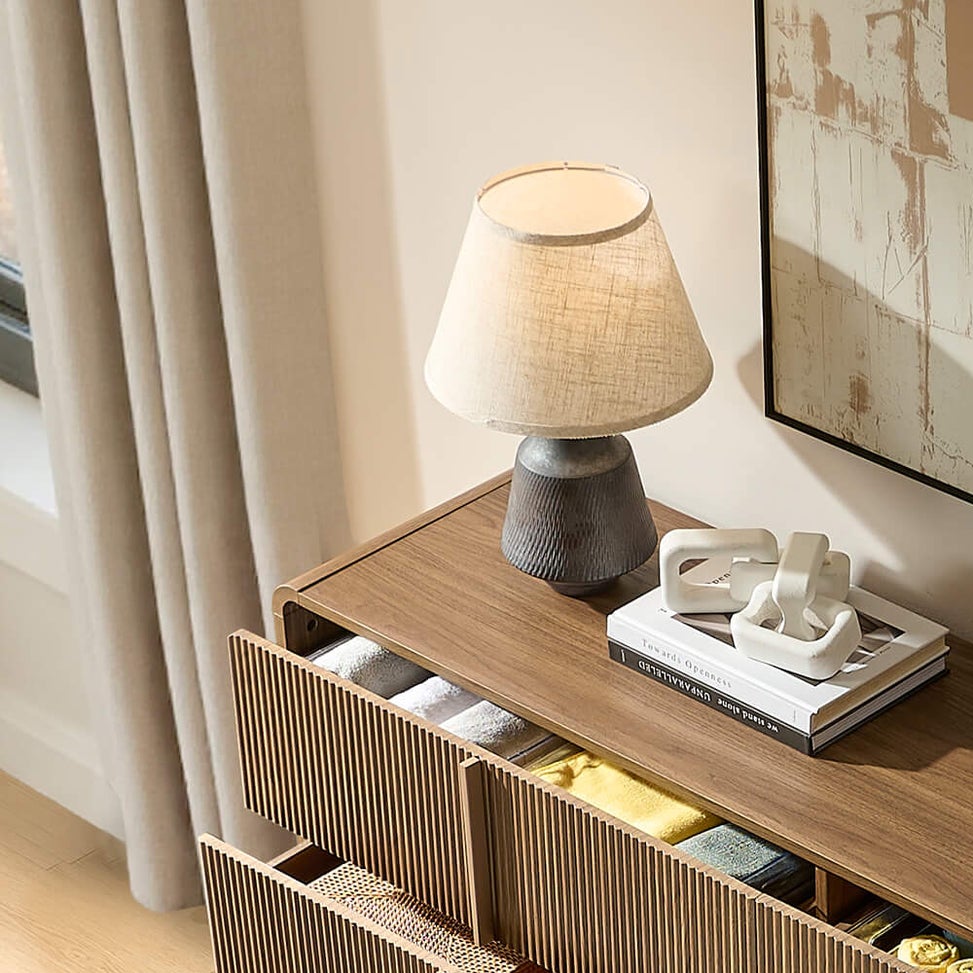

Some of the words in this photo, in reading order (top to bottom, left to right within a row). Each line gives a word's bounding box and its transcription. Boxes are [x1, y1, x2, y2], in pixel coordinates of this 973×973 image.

[641, 638, 682, 664] Towards
[685, 660, 733, 688] Openness
[638, 659, 711, 703] UNPARALLELED
[717, 698, 740, 715] alone
[742, 711, 766, 726] stand
[766, 722, 780, 733] we
